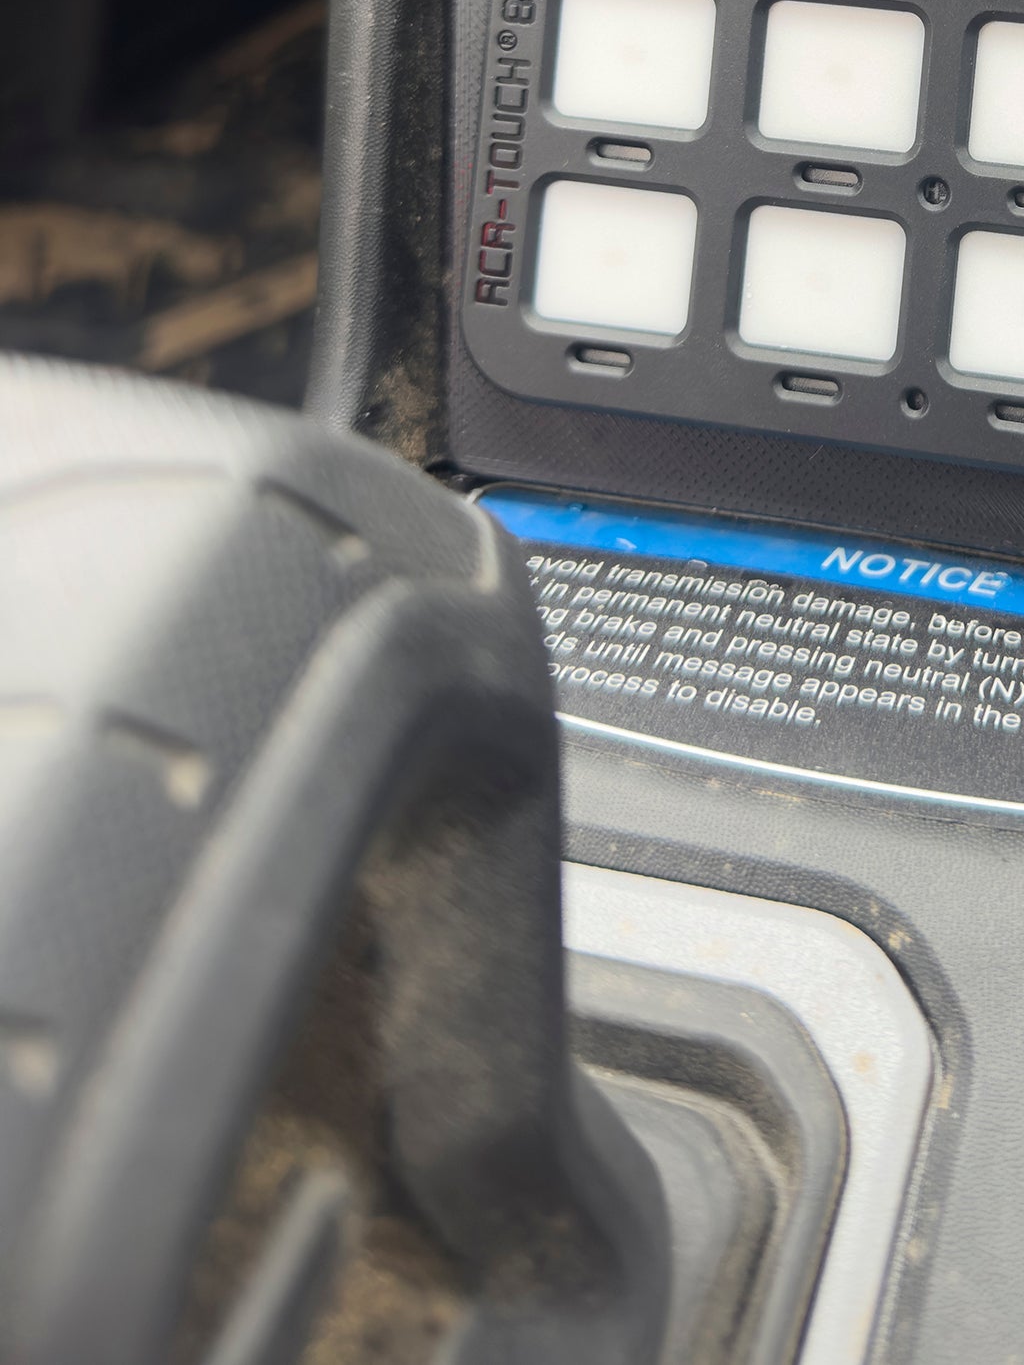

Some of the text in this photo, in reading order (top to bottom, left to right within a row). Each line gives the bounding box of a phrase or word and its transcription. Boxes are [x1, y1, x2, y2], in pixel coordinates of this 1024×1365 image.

[525, 555, 605, 582] avoid
[605, 562, 785, 608] transmission
[792, 590, 916, 632] damage,
[927, 612, 1022, 649] before
[820, 545, 1010, 597] NOTICE
[569, 585, 732, 626] permanent
[735, 608, 841, 643] neutral
[845, 628, 919, 658] state
[927, 638, 966, 668] by
[573, 607, 658, 639] brake
[662, 625, 725, 650] and
[725, 634, 856, 677] pressing
[863, 658, 971, 696] neutral
[583, 639, 651, 667] until
[653, 650, 794, 693] message
[800, 677, 927, 717] appears
[935, 695, 963, 723] in
[972, 702, 1022, 732] the
[664, 678, 698, 704] to
[704, 685, 822, 731] disable.
